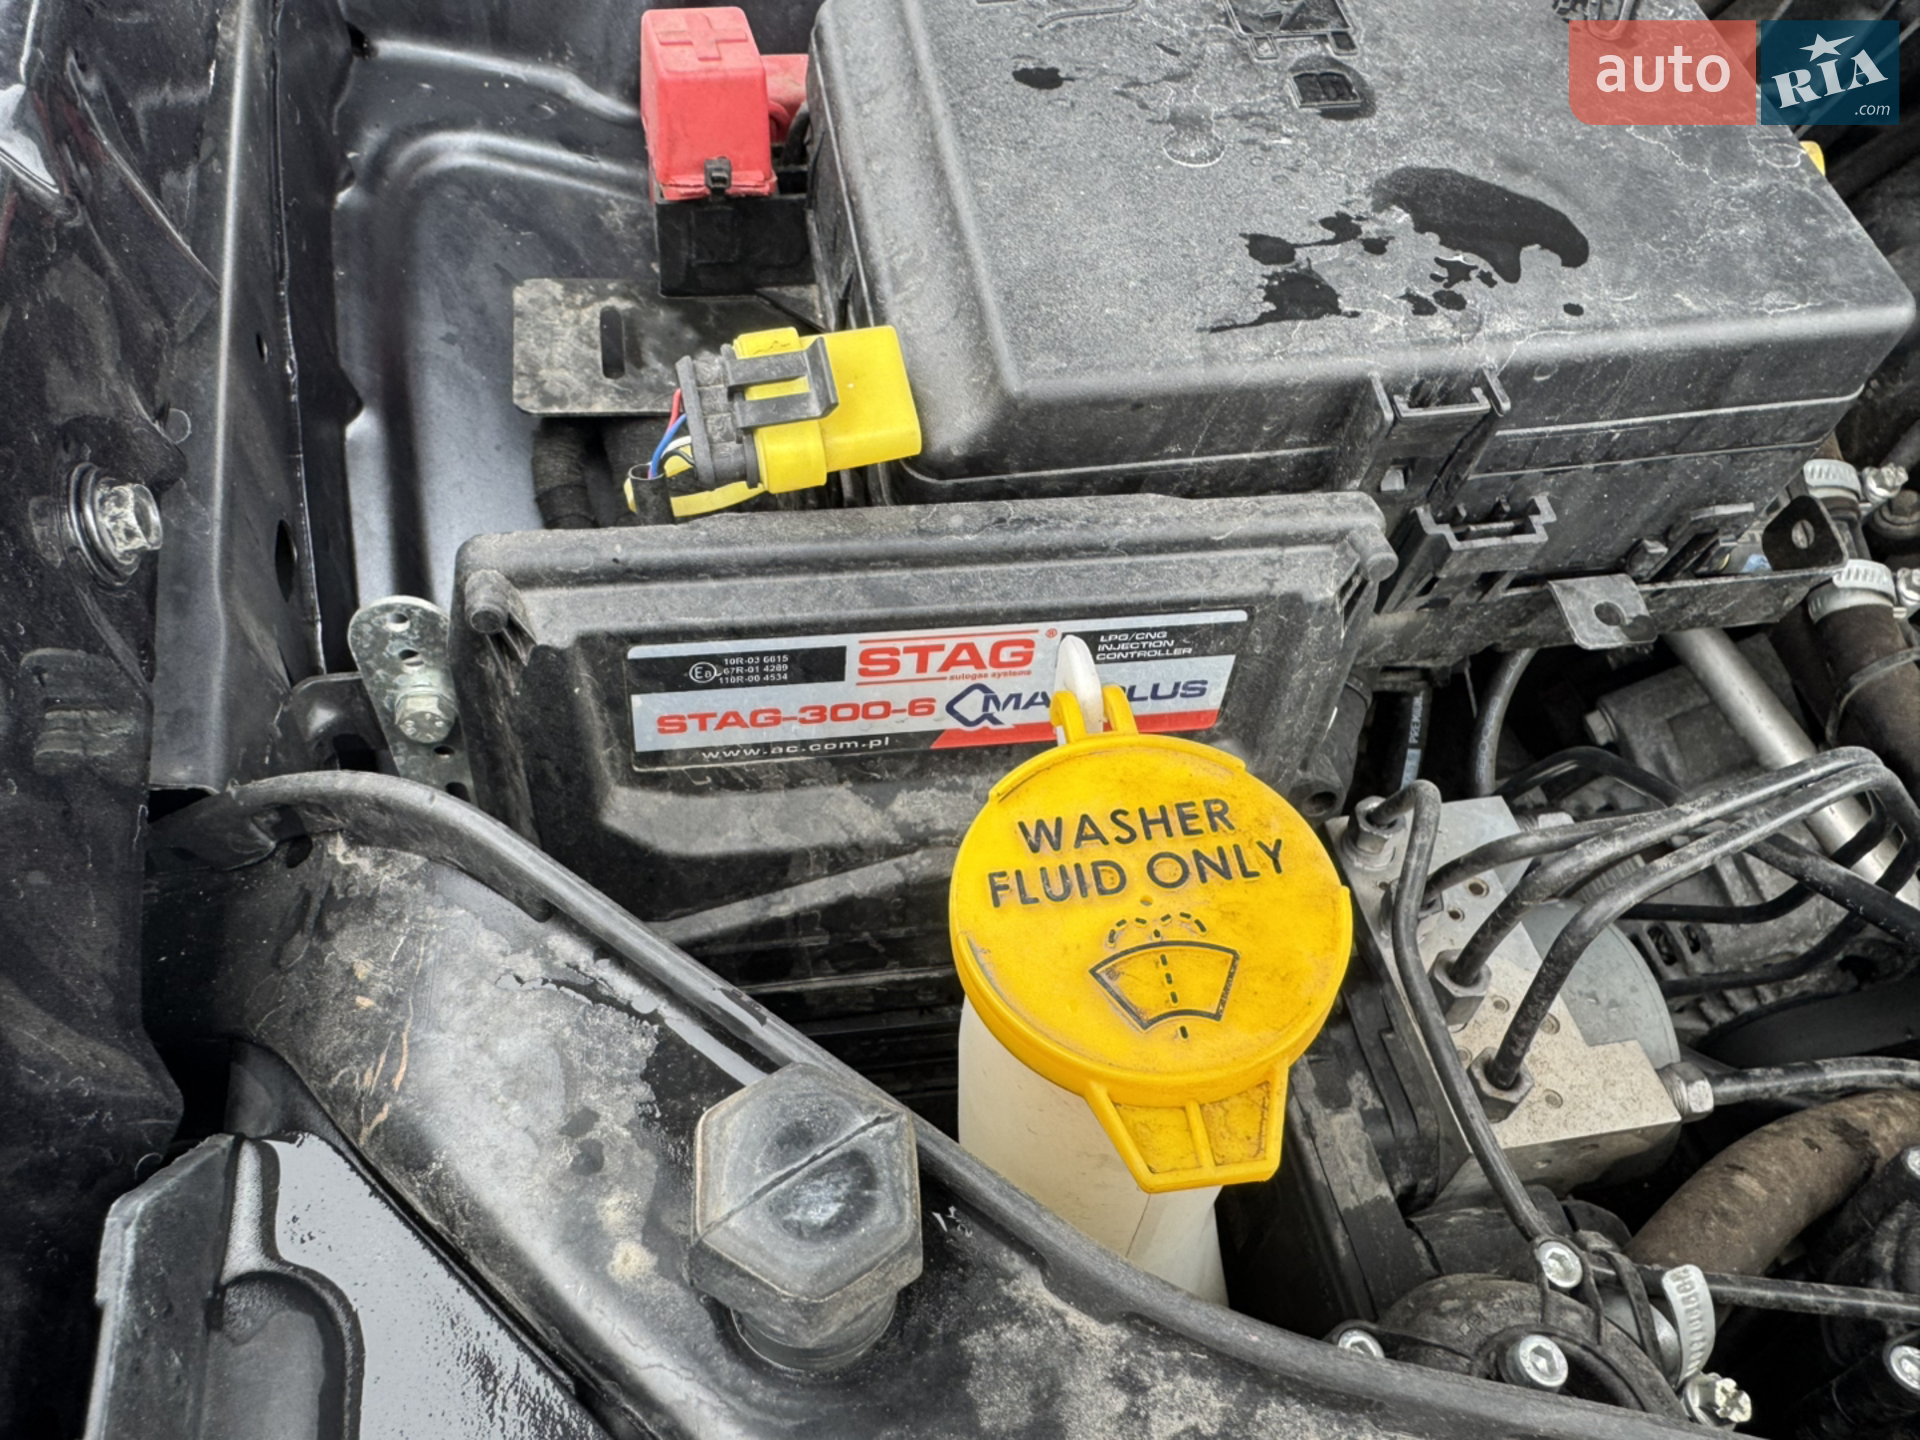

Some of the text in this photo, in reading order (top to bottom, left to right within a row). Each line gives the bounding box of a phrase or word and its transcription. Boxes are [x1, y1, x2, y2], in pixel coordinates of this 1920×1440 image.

[1097, 639, 1175, 652] INJECTION
[1100, 631, 1168, 643] LPG/CNG
[858, 639, 1036, 678] STAG
[1096, 647, 1193, 661] CONTROLLER
[949, 670, 1032, 681] autogas systems
[657, 697, 937, 735] STAG-300-6
[1120, 679, 1209, 702] LUS
[701, 736, 890, 760] www.ac.com.pl
[1017, 798, 1236, 854] WASHER
[987, 838, 1283, 908] FLUID ONLY
